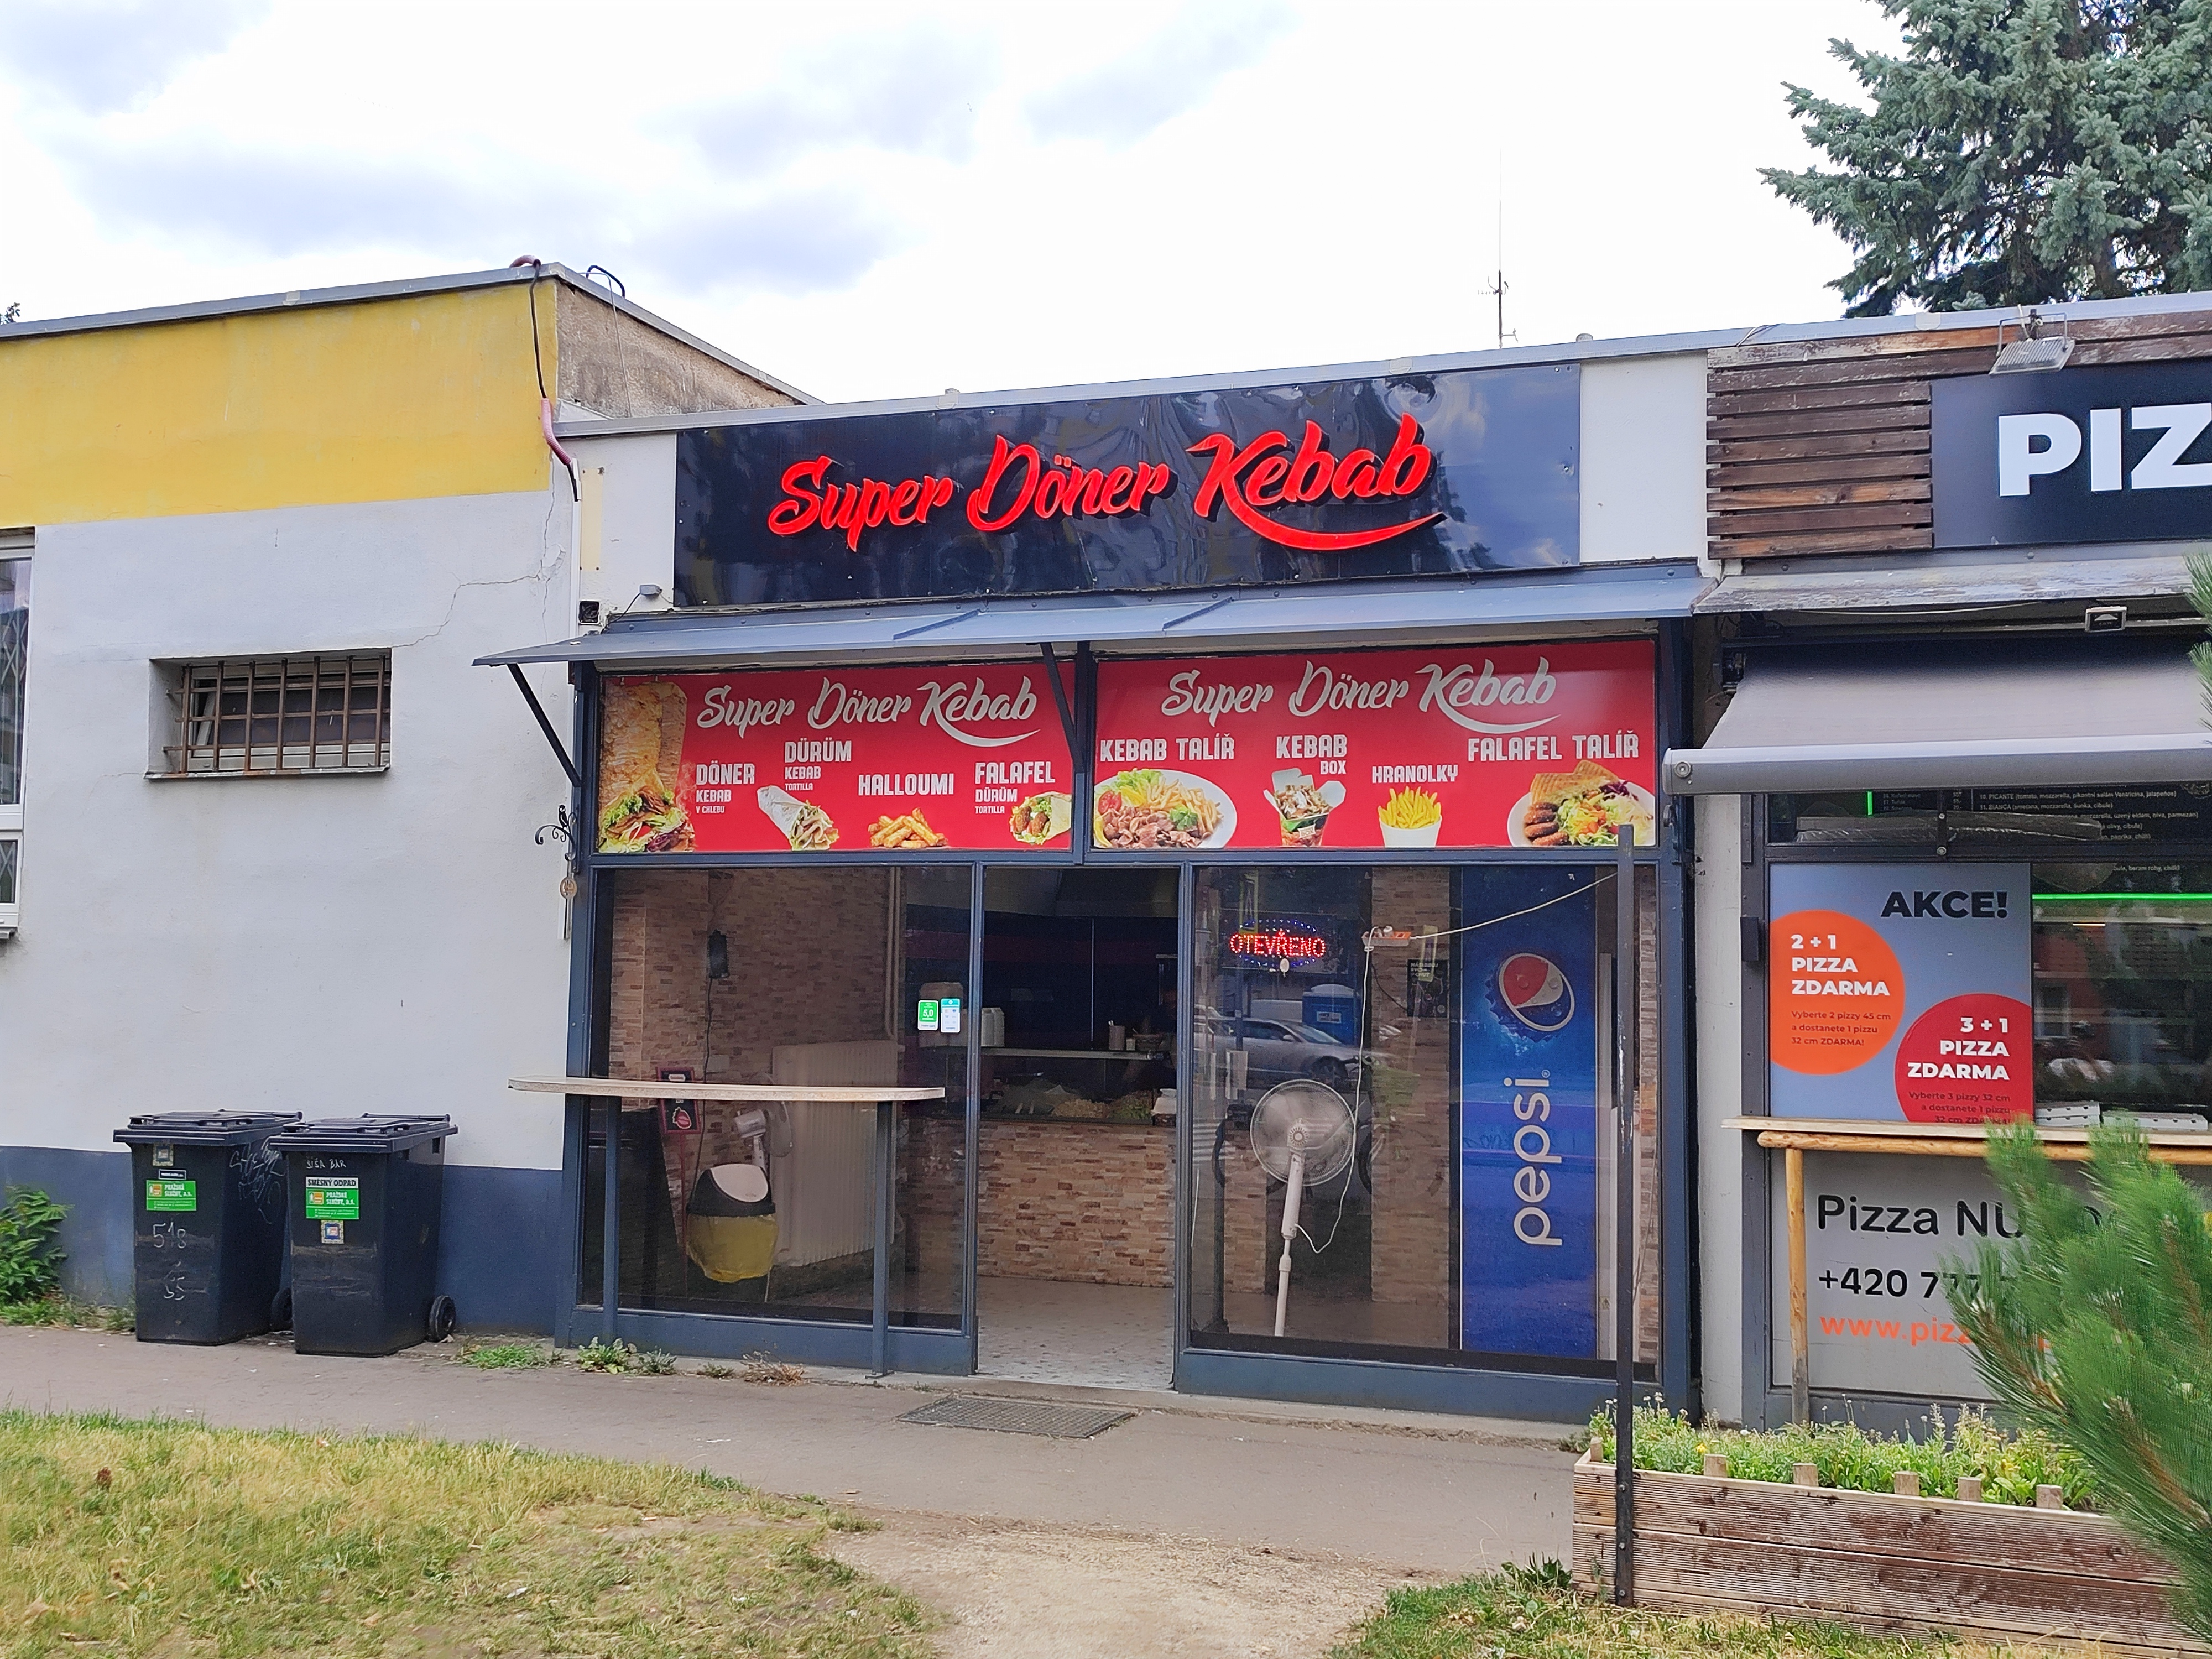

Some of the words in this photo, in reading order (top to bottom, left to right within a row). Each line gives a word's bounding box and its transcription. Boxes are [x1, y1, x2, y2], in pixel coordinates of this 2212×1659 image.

[1999, 403, 2212, 497] PIZ
[768, 455, 954, 552] Super
[967, 434, 1171, 531] Döner
[1186, 413, 1444, 551] Kebab
[1161, 669, 1273, 727] Super
[1289, 660, 1409, 717] Döner
[1415, 656, 1561, 734] Kebab
[697, 685, 795, 739] Super
[808, 677, 911, 729] Döner
[917, 676, 1041, 748] Kebab
[785, 738, 852, 763] DÜRÜM
[1100, 739, 1167, 762] KEBAB
[1176, 733, 1235, 760] TALÍŘ
[1276, 734, 1348, 759] KEBAB
[1468, 736, 1563, 762] FALAFEL
[1572, 730, 1639, 759] TALÍŘ
[696, 760, 755, 785] DÖNER
[785, 766, 821, 780] KEBAB
[975, 761, 1056, 784] FALAFEL
[1320, 761, 1347, 775] BOX
[1371, 764, 1459, 784] HRANOLKY
[858, 773, 954, 796] HALLOUMI
[975, 787, 1018, 802] DÜRÜM
[696, 789, 731, 802] KEBAB
[1880, 891, 2008, 919] AKCE!
[1229, 931, 1326, 958] OTEVŘENO
[1791, 935, 1804, 950] 2
[1810, 937, 1822, 948] +
[1828, 935, 1837, 950] 1
[1792, 958, 1858, 973] PIZZA
[1791, 980, 1890, 996] ZDARMA
[1791, 1011, 1827, 1020] Vyberte
[1837, 1011, 1860, 1021] pizzy
[1960, 1017, 1974, 1032] 3
[1981, 1020, 1993, 1031] +
[1999, 1018, 2008, 1033] 1
[1799, 1024, 1845, 1032] dostanete
[1853, 1025, 1878, 1034] pizzu
[1820, 1037, 1865, 1046] ZDARMA!
[1940, 1040, 2010, 1057] PIZZA
[1907, 1063, 2010, 1080] ZDARMA
[1908, 1092, 1945, 1101] Vyberte
[1956, 1093, 1980, 1102] pizzy
[1983, 1093, 1993, 1102] 32
[1929, 1104, 1977, 1113] dostanete
[1504, 1078, 1562, 1246] pepsi
[1818, 1194, 1939, 1235] Pizza
[1818, 1268, 1908, 1297] +420
